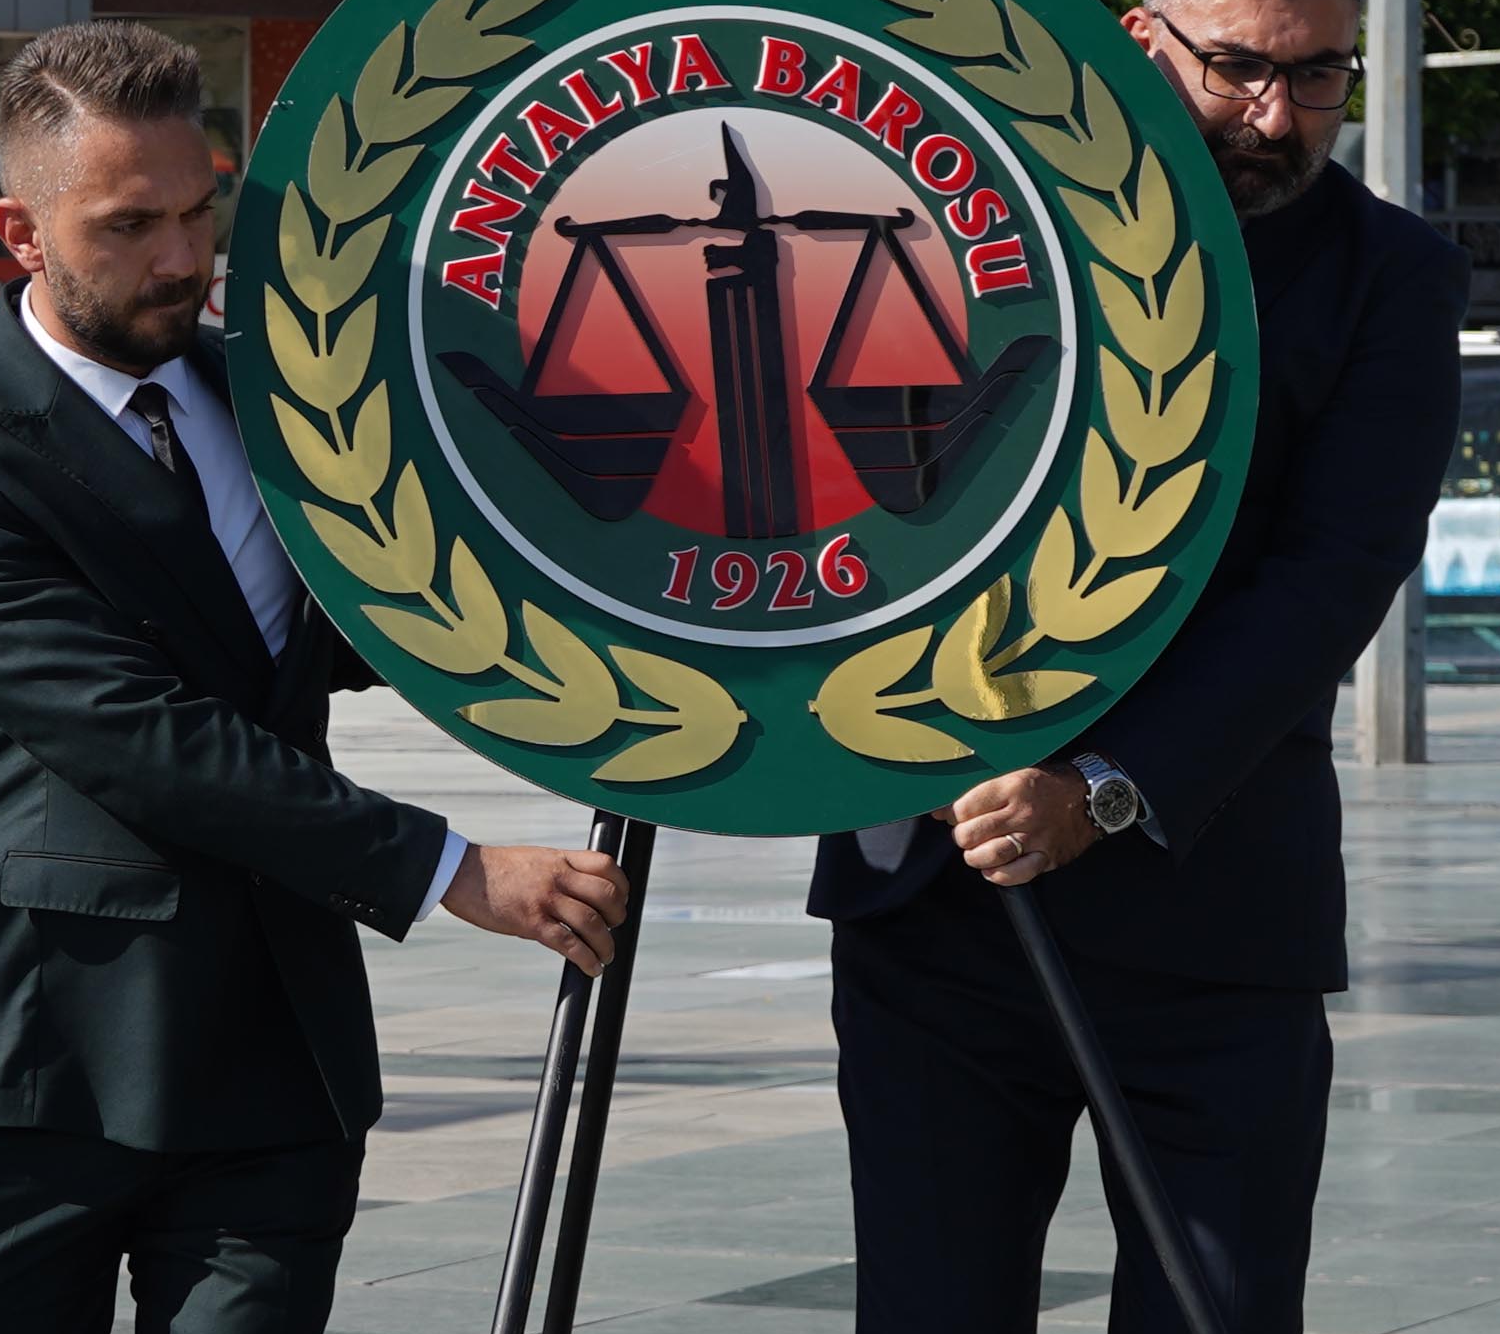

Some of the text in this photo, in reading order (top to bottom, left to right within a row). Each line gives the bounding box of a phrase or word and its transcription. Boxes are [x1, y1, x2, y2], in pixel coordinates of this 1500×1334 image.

[441, 33, 1033, 311] ANTALYA BAROSU
[661, 532, 869, 612] 1926
